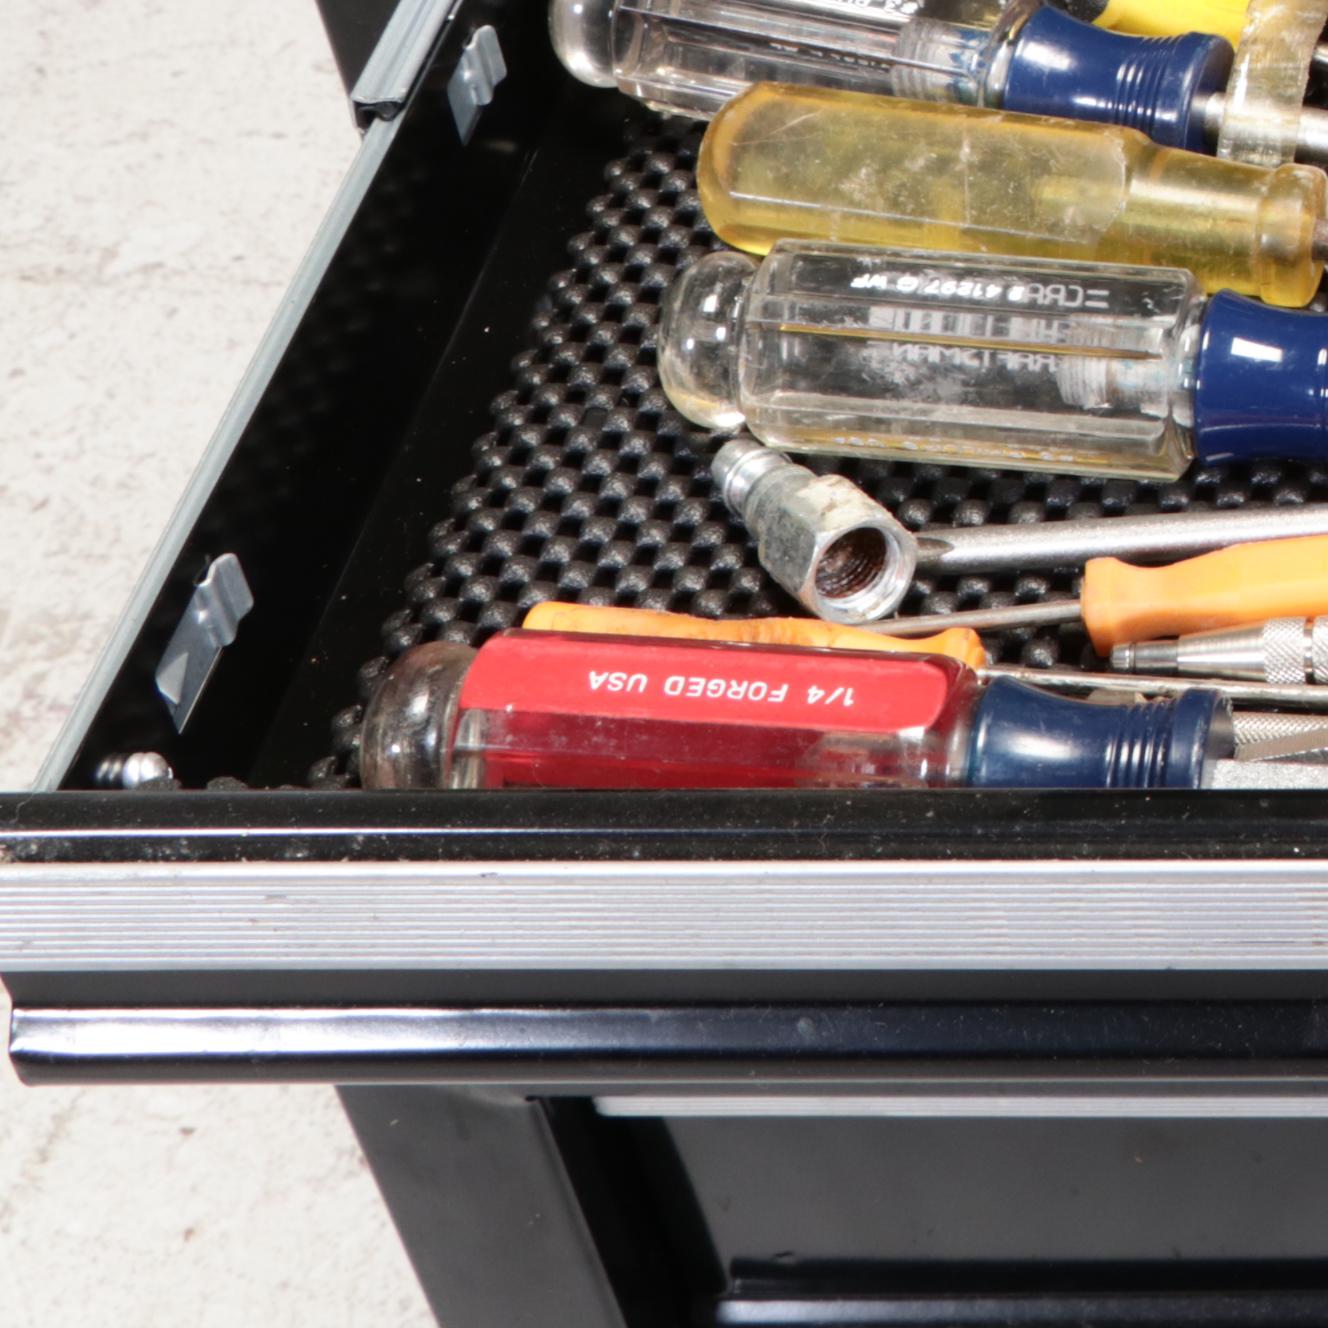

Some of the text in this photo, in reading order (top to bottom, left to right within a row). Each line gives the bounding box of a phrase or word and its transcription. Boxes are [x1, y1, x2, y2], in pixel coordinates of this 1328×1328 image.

[588, 670, 856, 708] 1/4 FORGED USA
